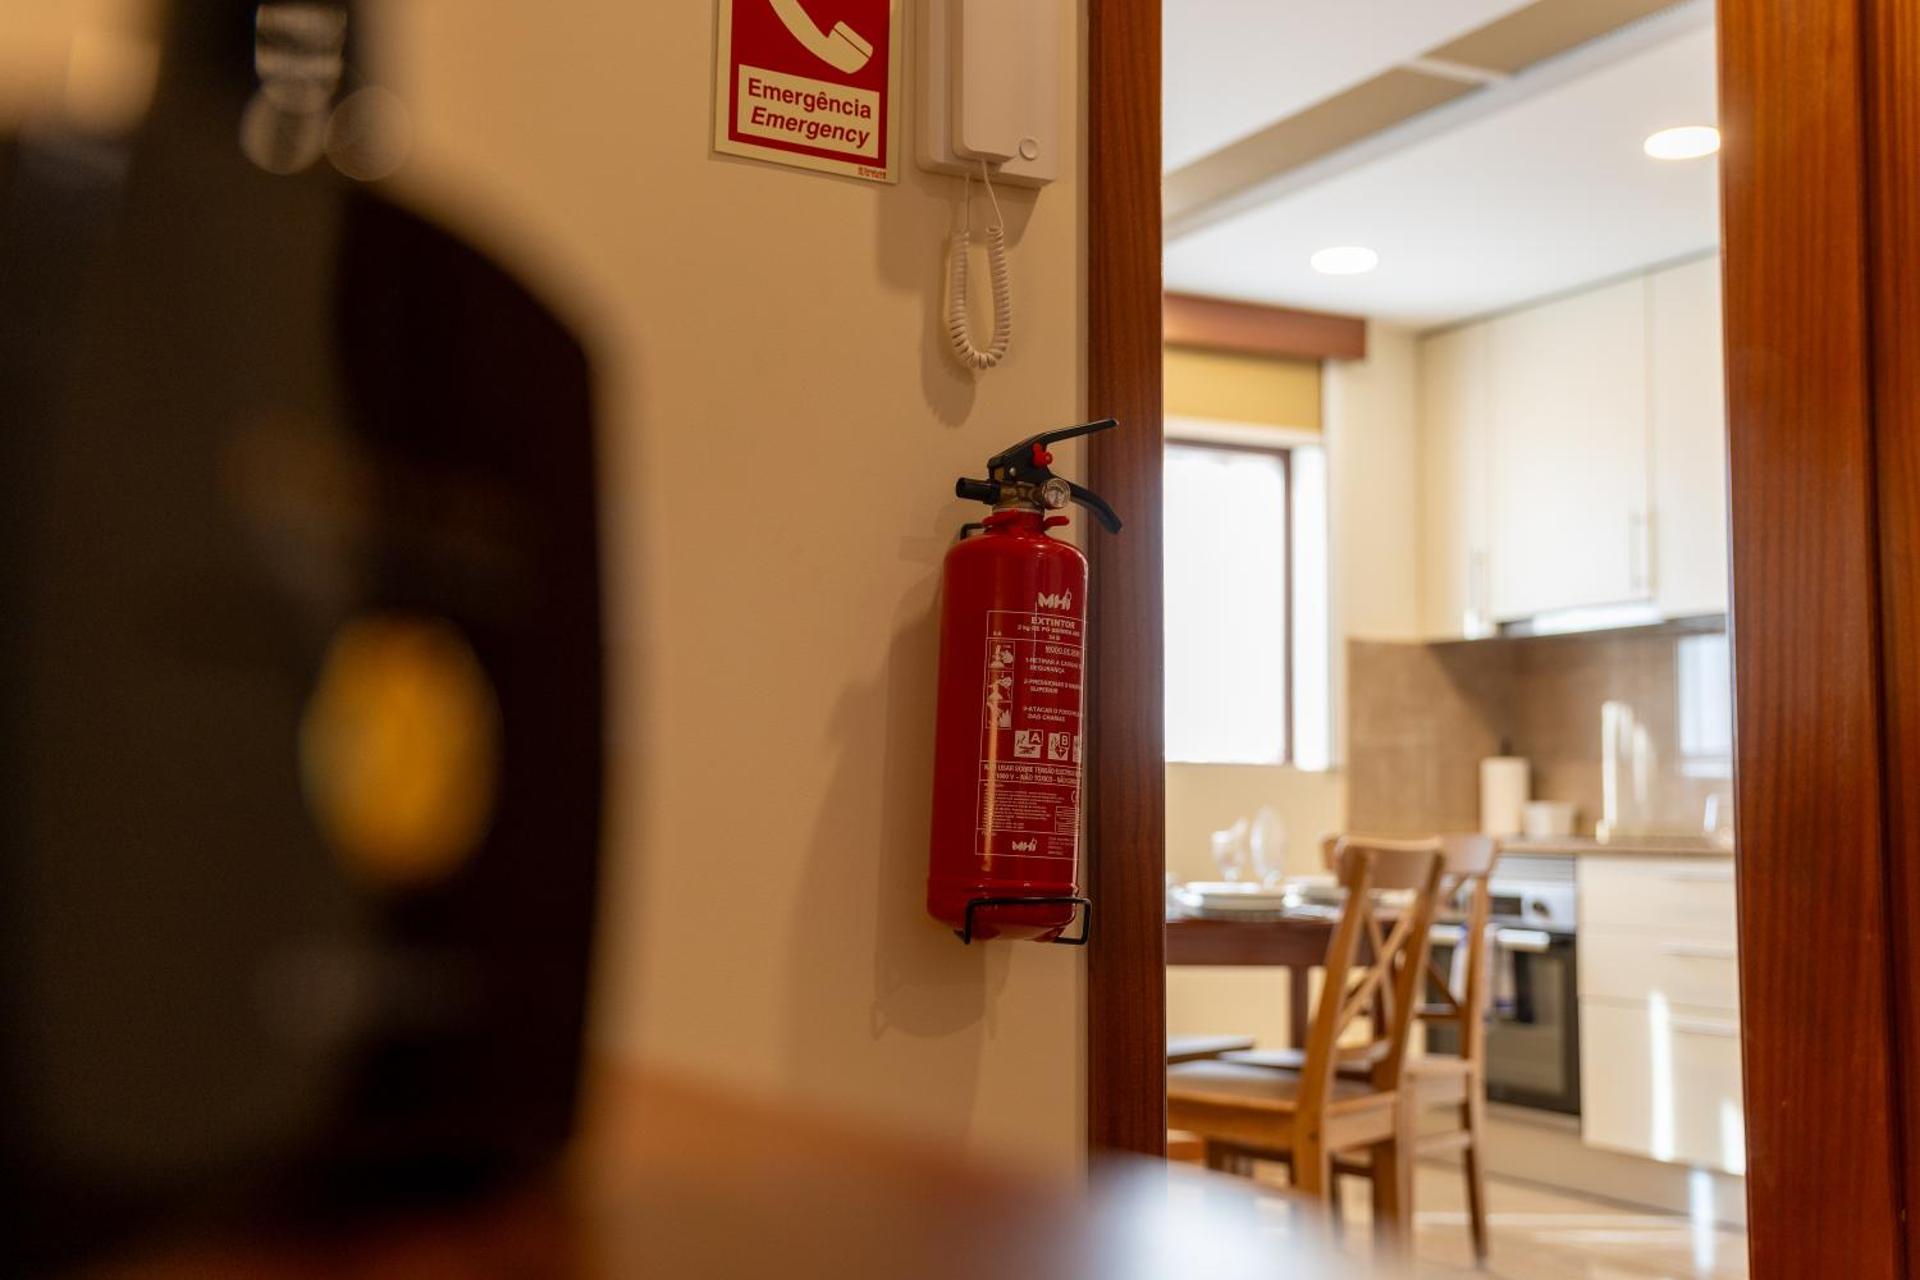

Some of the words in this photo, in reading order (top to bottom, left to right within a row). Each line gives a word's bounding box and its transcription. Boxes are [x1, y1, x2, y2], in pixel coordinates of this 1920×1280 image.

[748, 77, 871, 119] Emergência
[751, 106, 871, 148] Emergency
[1031, 616, 1075, 630] EXTINTOR
[1030, 732, 1041, 743] A
[1061, 735, 1068, 746] B
